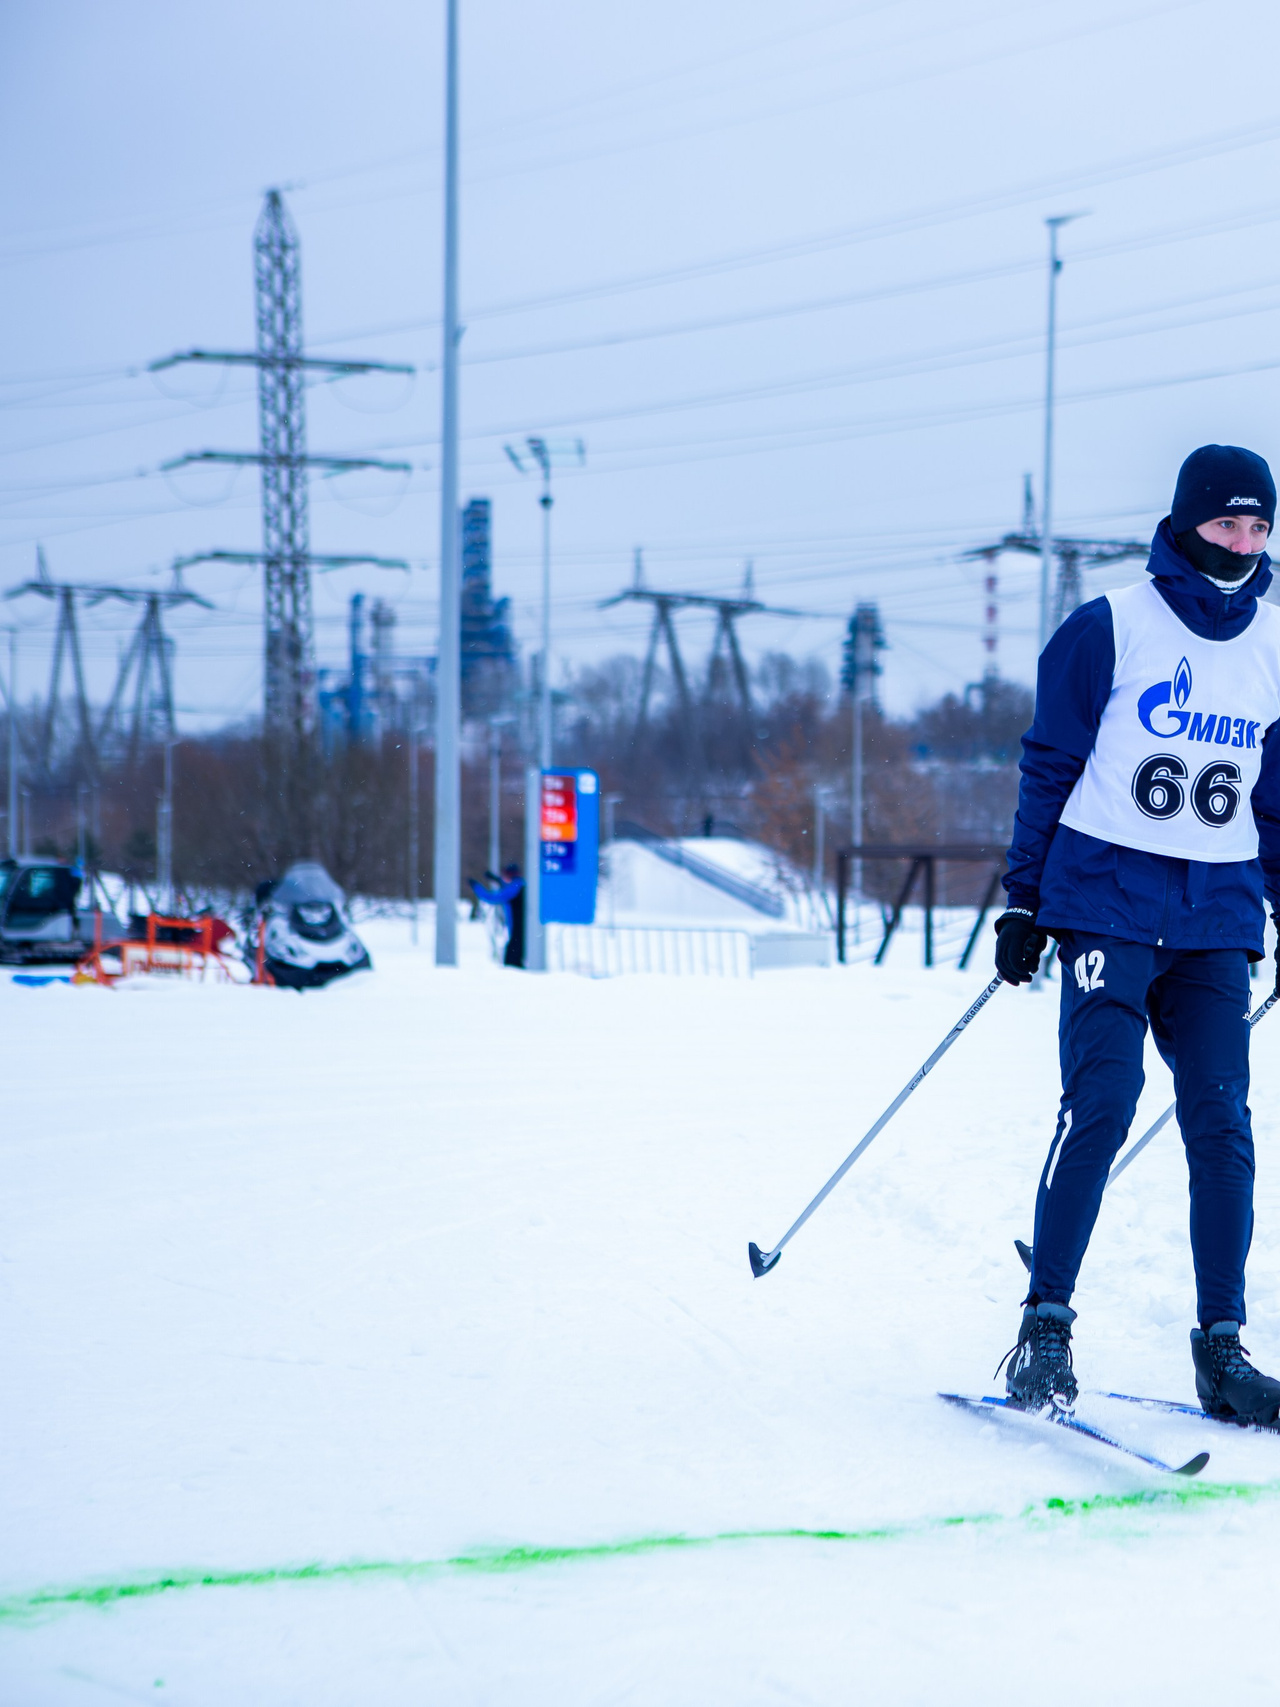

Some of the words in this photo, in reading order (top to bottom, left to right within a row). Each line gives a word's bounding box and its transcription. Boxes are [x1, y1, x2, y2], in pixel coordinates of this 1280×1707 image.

[1226, 496, 1261, 506] JÖGEL
[1131, 752, 1242, 828] 66
[1074, 949, 1105, 993] 42
[962, 992, 990, 1025] NORDWAY
